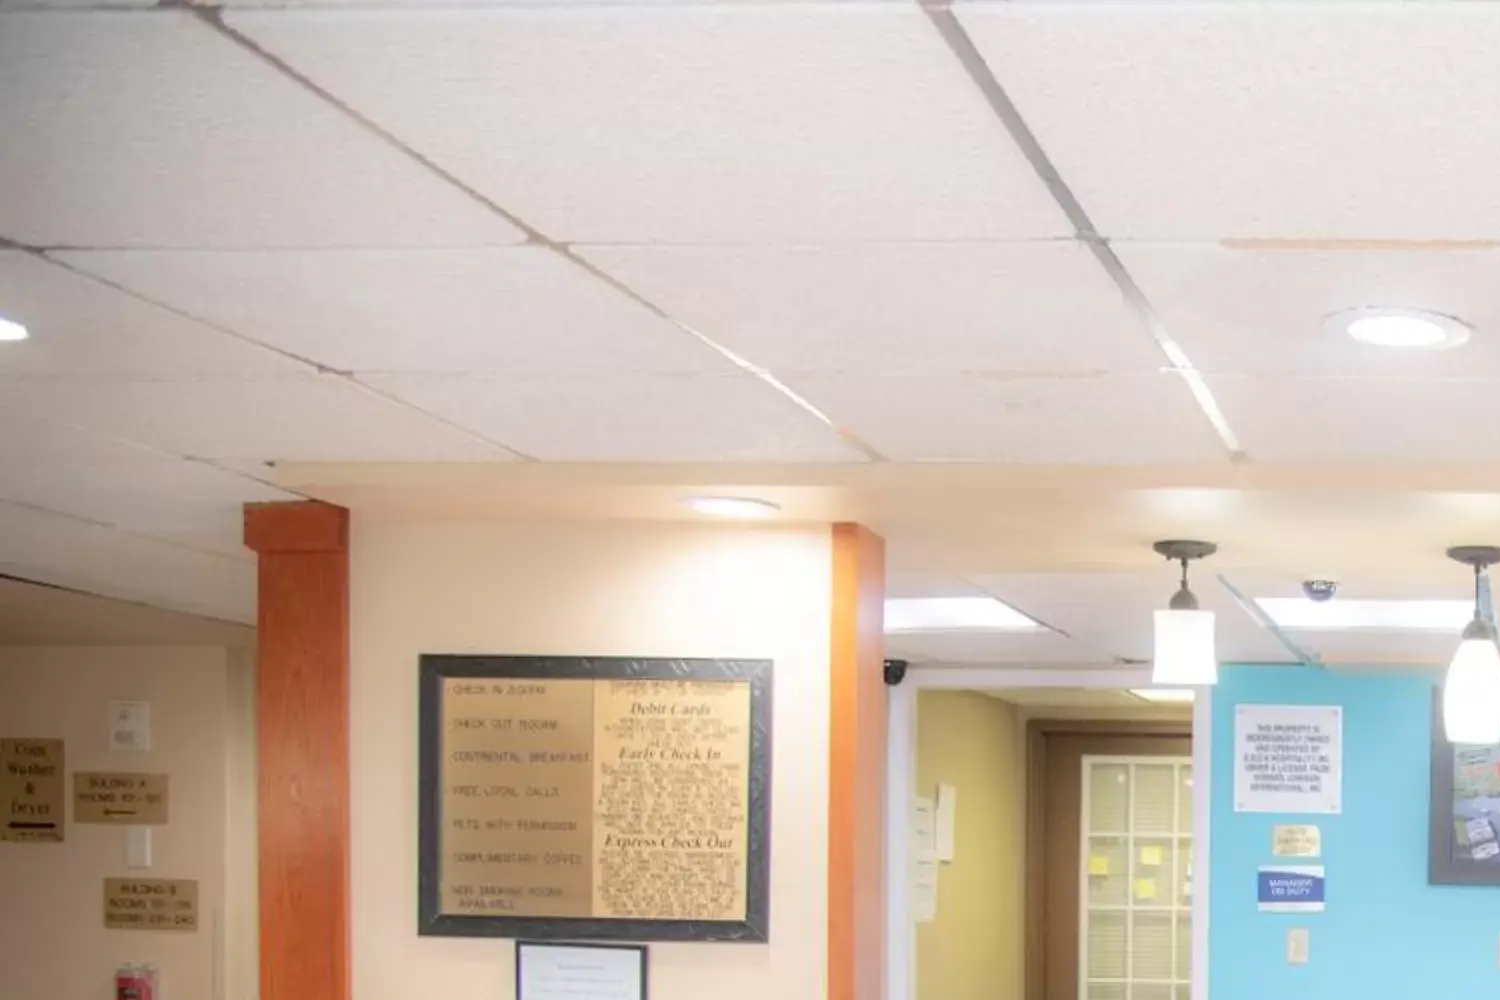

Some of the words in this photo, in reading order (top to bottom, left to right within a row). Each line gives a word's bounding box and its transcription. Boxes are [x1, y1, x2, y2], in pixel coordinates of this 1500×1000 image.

[630, 702, 667, 715] Debit
[671, 703, 711, 715] Cards
[452, 718, 486, 730] CHECK
[490, 718, 513, 730] OUT
[452, 751, 521, 763] CONTINENTAL
[529, 751, 590, 763] BREAKFAST
[618, 747, 656, 762] Early
[660, 747, 701, 760] Check
[706, 747, 722, 760] In
[7, 763, 56, 777] Washer
[452, 785, 479, 797] FREE
[483, 785, 520, 798] LOCAL
[10, 797, 50, 816] Dryer
[604, 833, 657, 850] Express
[660, 834, 701, 849] Check
[706, 833, 734, 849] Out
